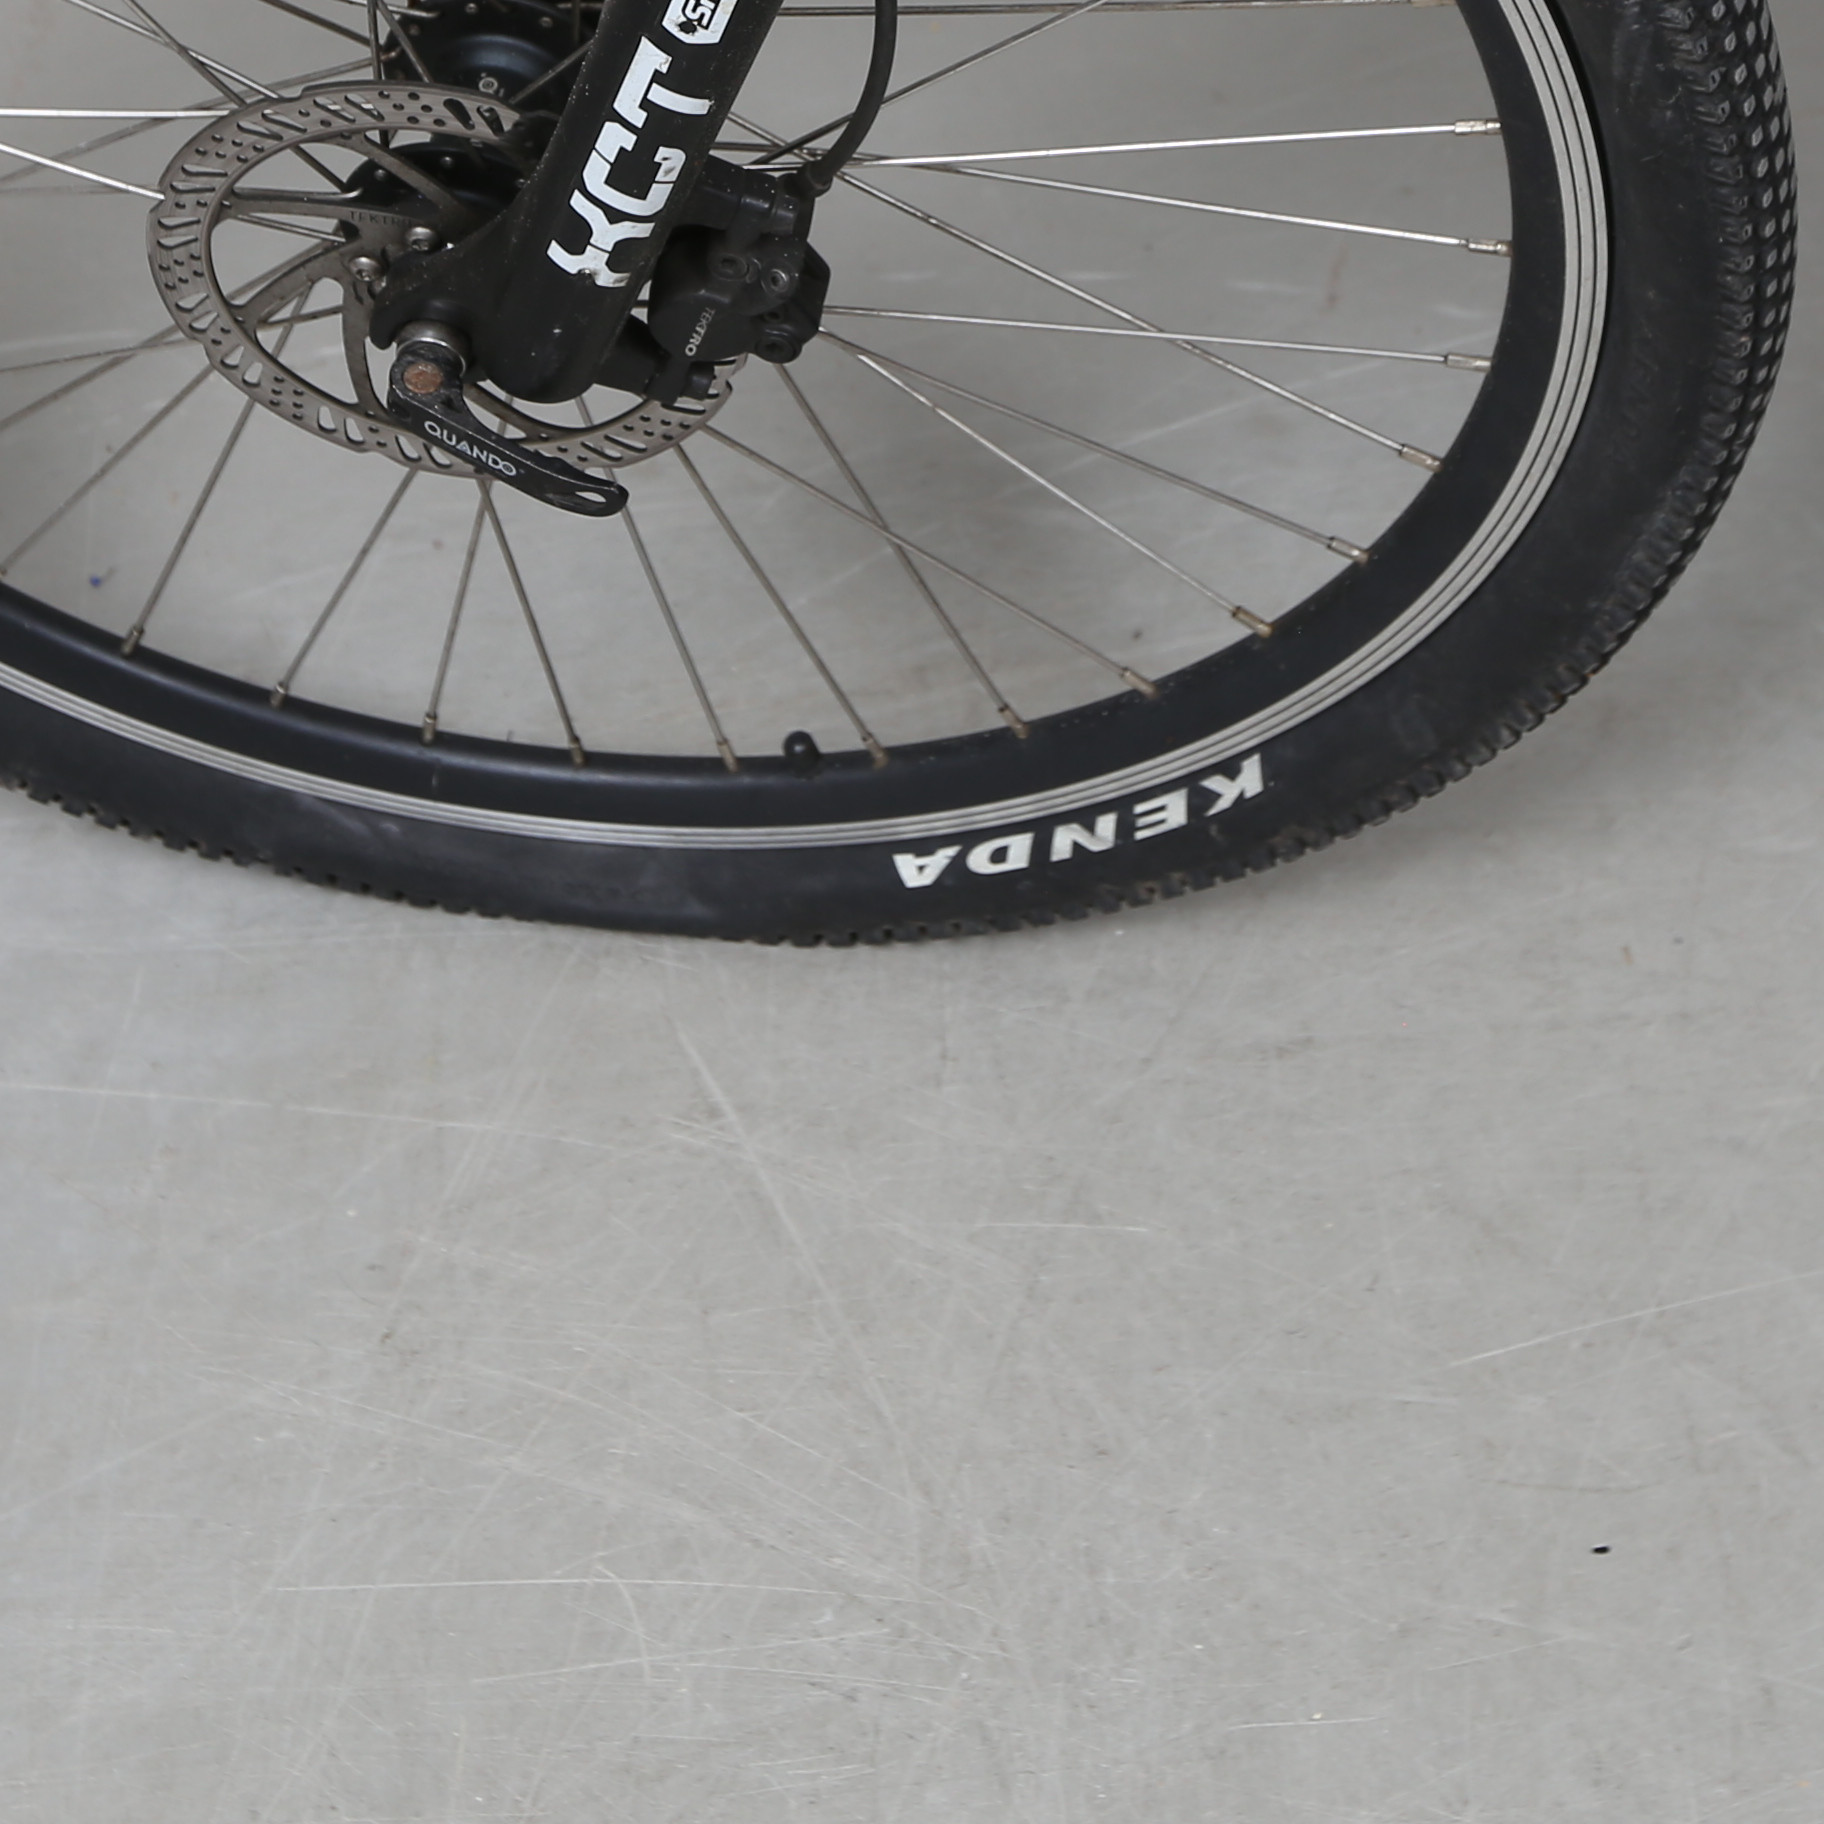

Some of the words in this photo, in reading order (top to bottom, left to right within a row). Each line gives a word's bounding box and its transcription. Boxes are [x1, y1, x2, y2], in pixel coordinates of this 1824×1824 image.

[547, 35, 714, 289] XCT
[683, 307, 716, 357] TEKTRO
[424, 420, 517, 477] QUANDO
[891, 753, 1265, 889] KENDA
